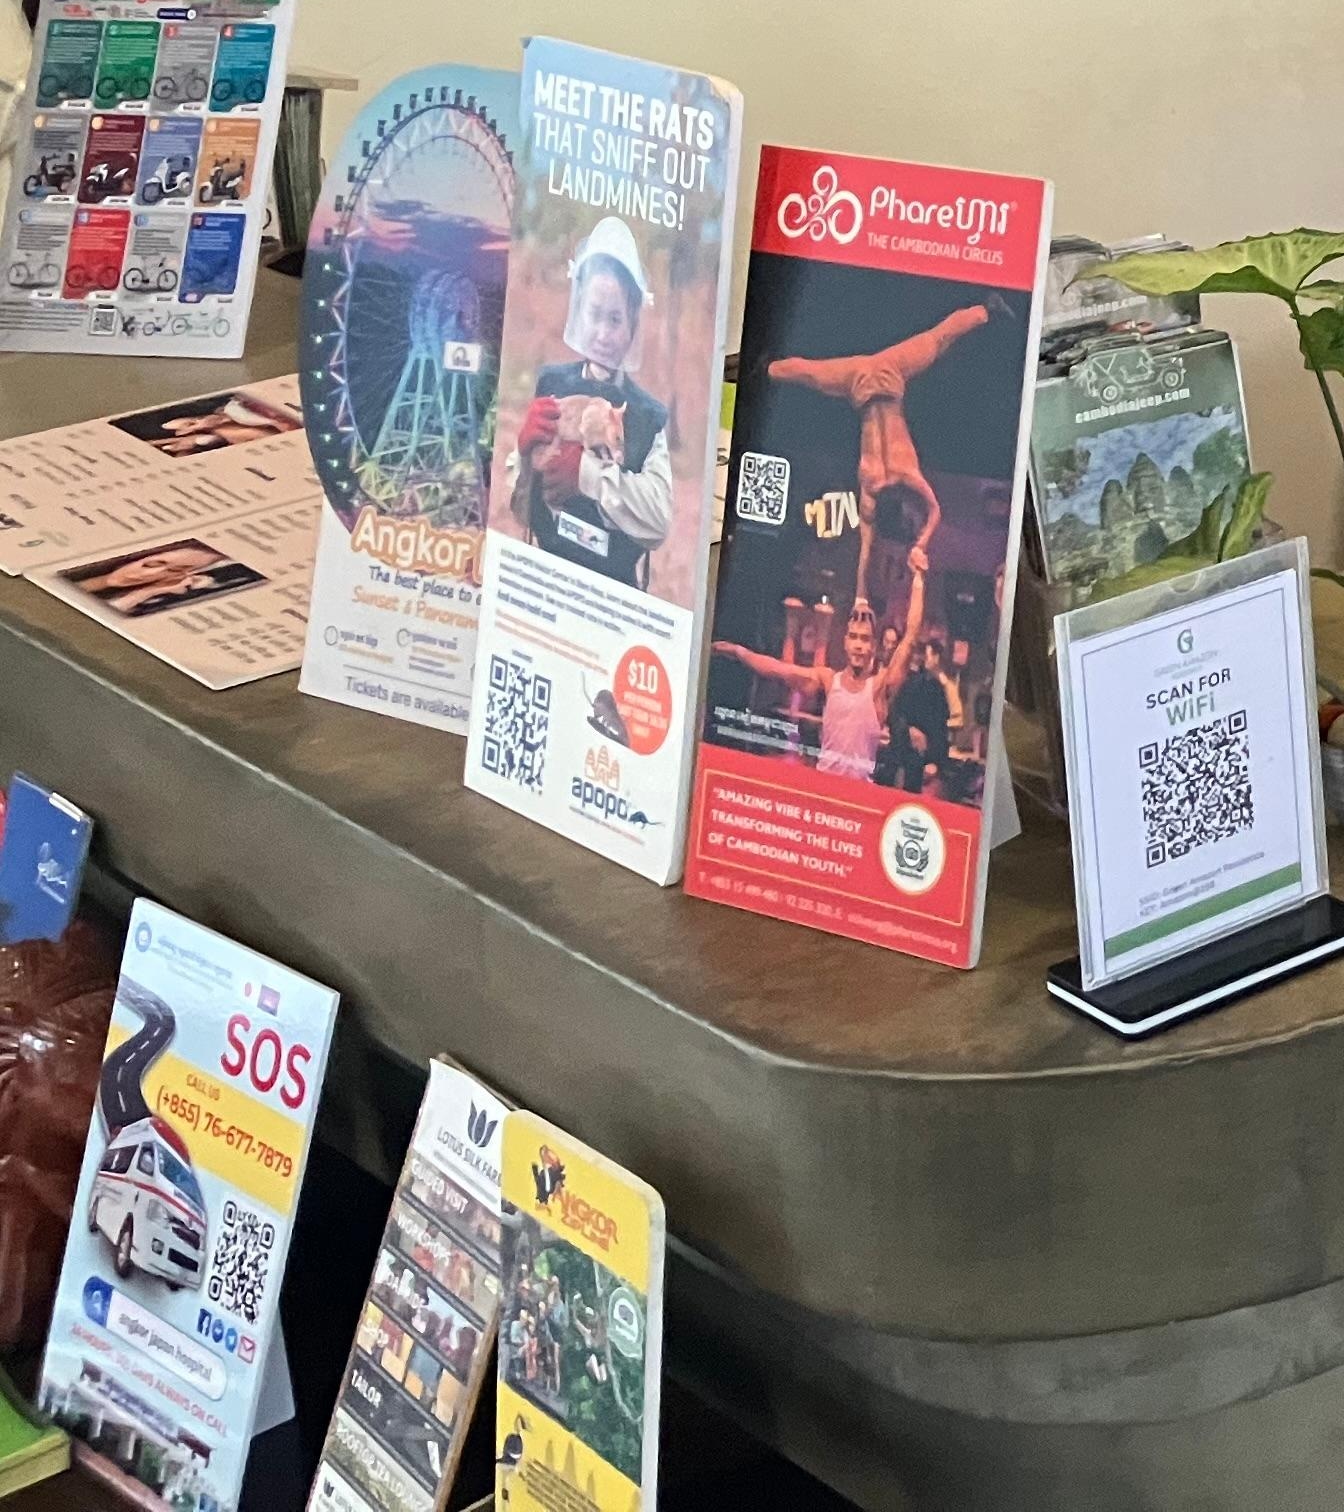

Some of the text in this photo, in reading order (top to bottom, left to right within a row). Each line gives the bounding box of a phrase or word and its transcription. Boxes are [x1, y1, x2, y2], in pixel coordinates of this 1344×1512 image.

[533, 69, 715, 150] MEET THE RATS
[533, 112, 711, 193] THAT SNIFF OUT
[548, 158, 685, 231] LANDMINES!
[869, 185, 954, 228] Phare
[867, 231, 1004, 265] THE CAMBODIAN CIRCUS
[1075, 388, 1191, 424] cambodiajeep.com
[354, 510, 472, 571] Angkor
[352, 585, 399, 612] Sunset
[369, 564, 473, 603] The best place to
[627, 658, 659, 694] $10
[1146, 681, 1193, 709] SCAN
[1198, 668, 1231, 691] FOR
[344, 675, 470, 722] Tickets are available
[571, 775, 628, 819] apopo
[775, 799, 801, 820] VIBE
[803, 807, 811, 822] &
[814, 810, 862, 834] ENERGY
[707, 832, 725, 845] OF
[726, 835, 799, 866] CAMBODIAN
[711, 808, 863, 858] TRANSFORMING THE LIVES
[220, 1013, 312, 1110] SOS
[186, 1073, 221, 1101] CALL US
[156, 1085, 294, 1178] (+855) 76-677-7879
[436, 1125, 464, 1157] LOTUS
[464, 1146, 482, 1172] SILK
[445, 1180, 469, 1215] VISIT
[351, 1368, 382, 1409] TAILOR
